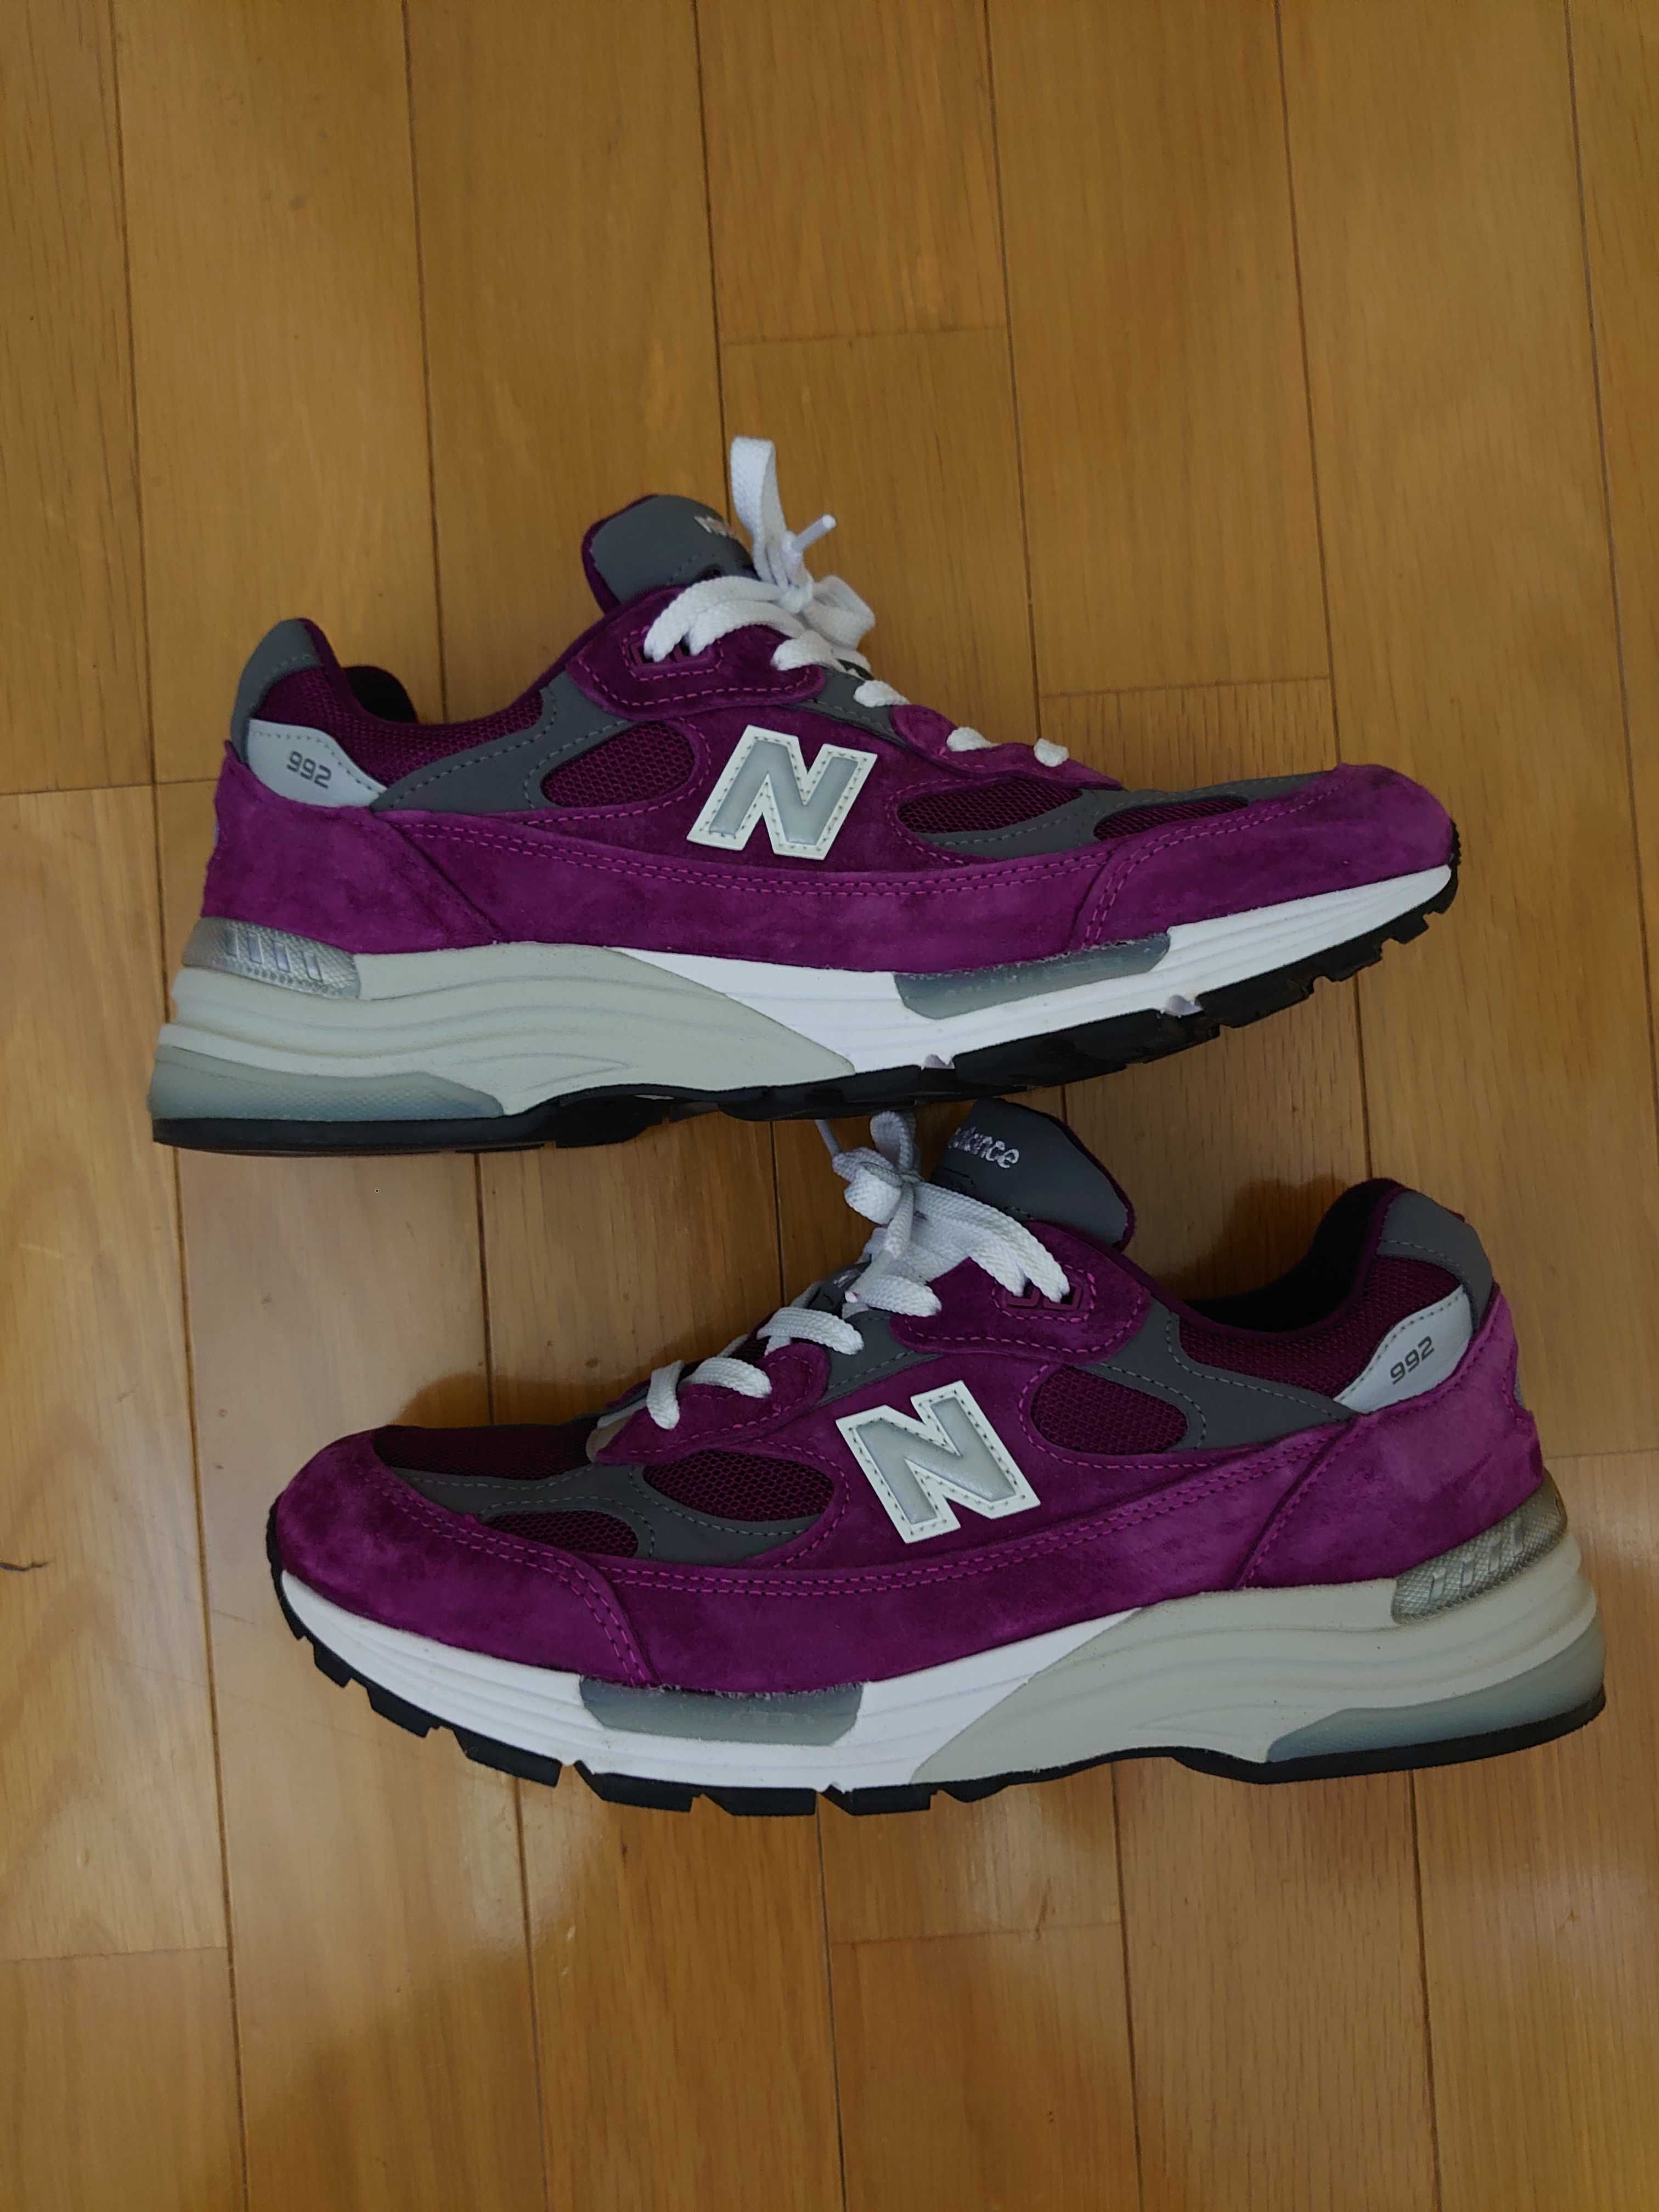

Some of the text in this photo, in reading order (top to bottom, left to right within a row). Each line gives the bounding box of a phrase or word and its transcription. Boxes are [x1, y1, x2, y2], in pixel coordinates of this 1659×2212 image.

[286, 751, 332, 789] 992
[686, 724, 878, 861] N
[1390, 1336, 1435, 1384] 992
[836, 1380, 1041, 1544] N
